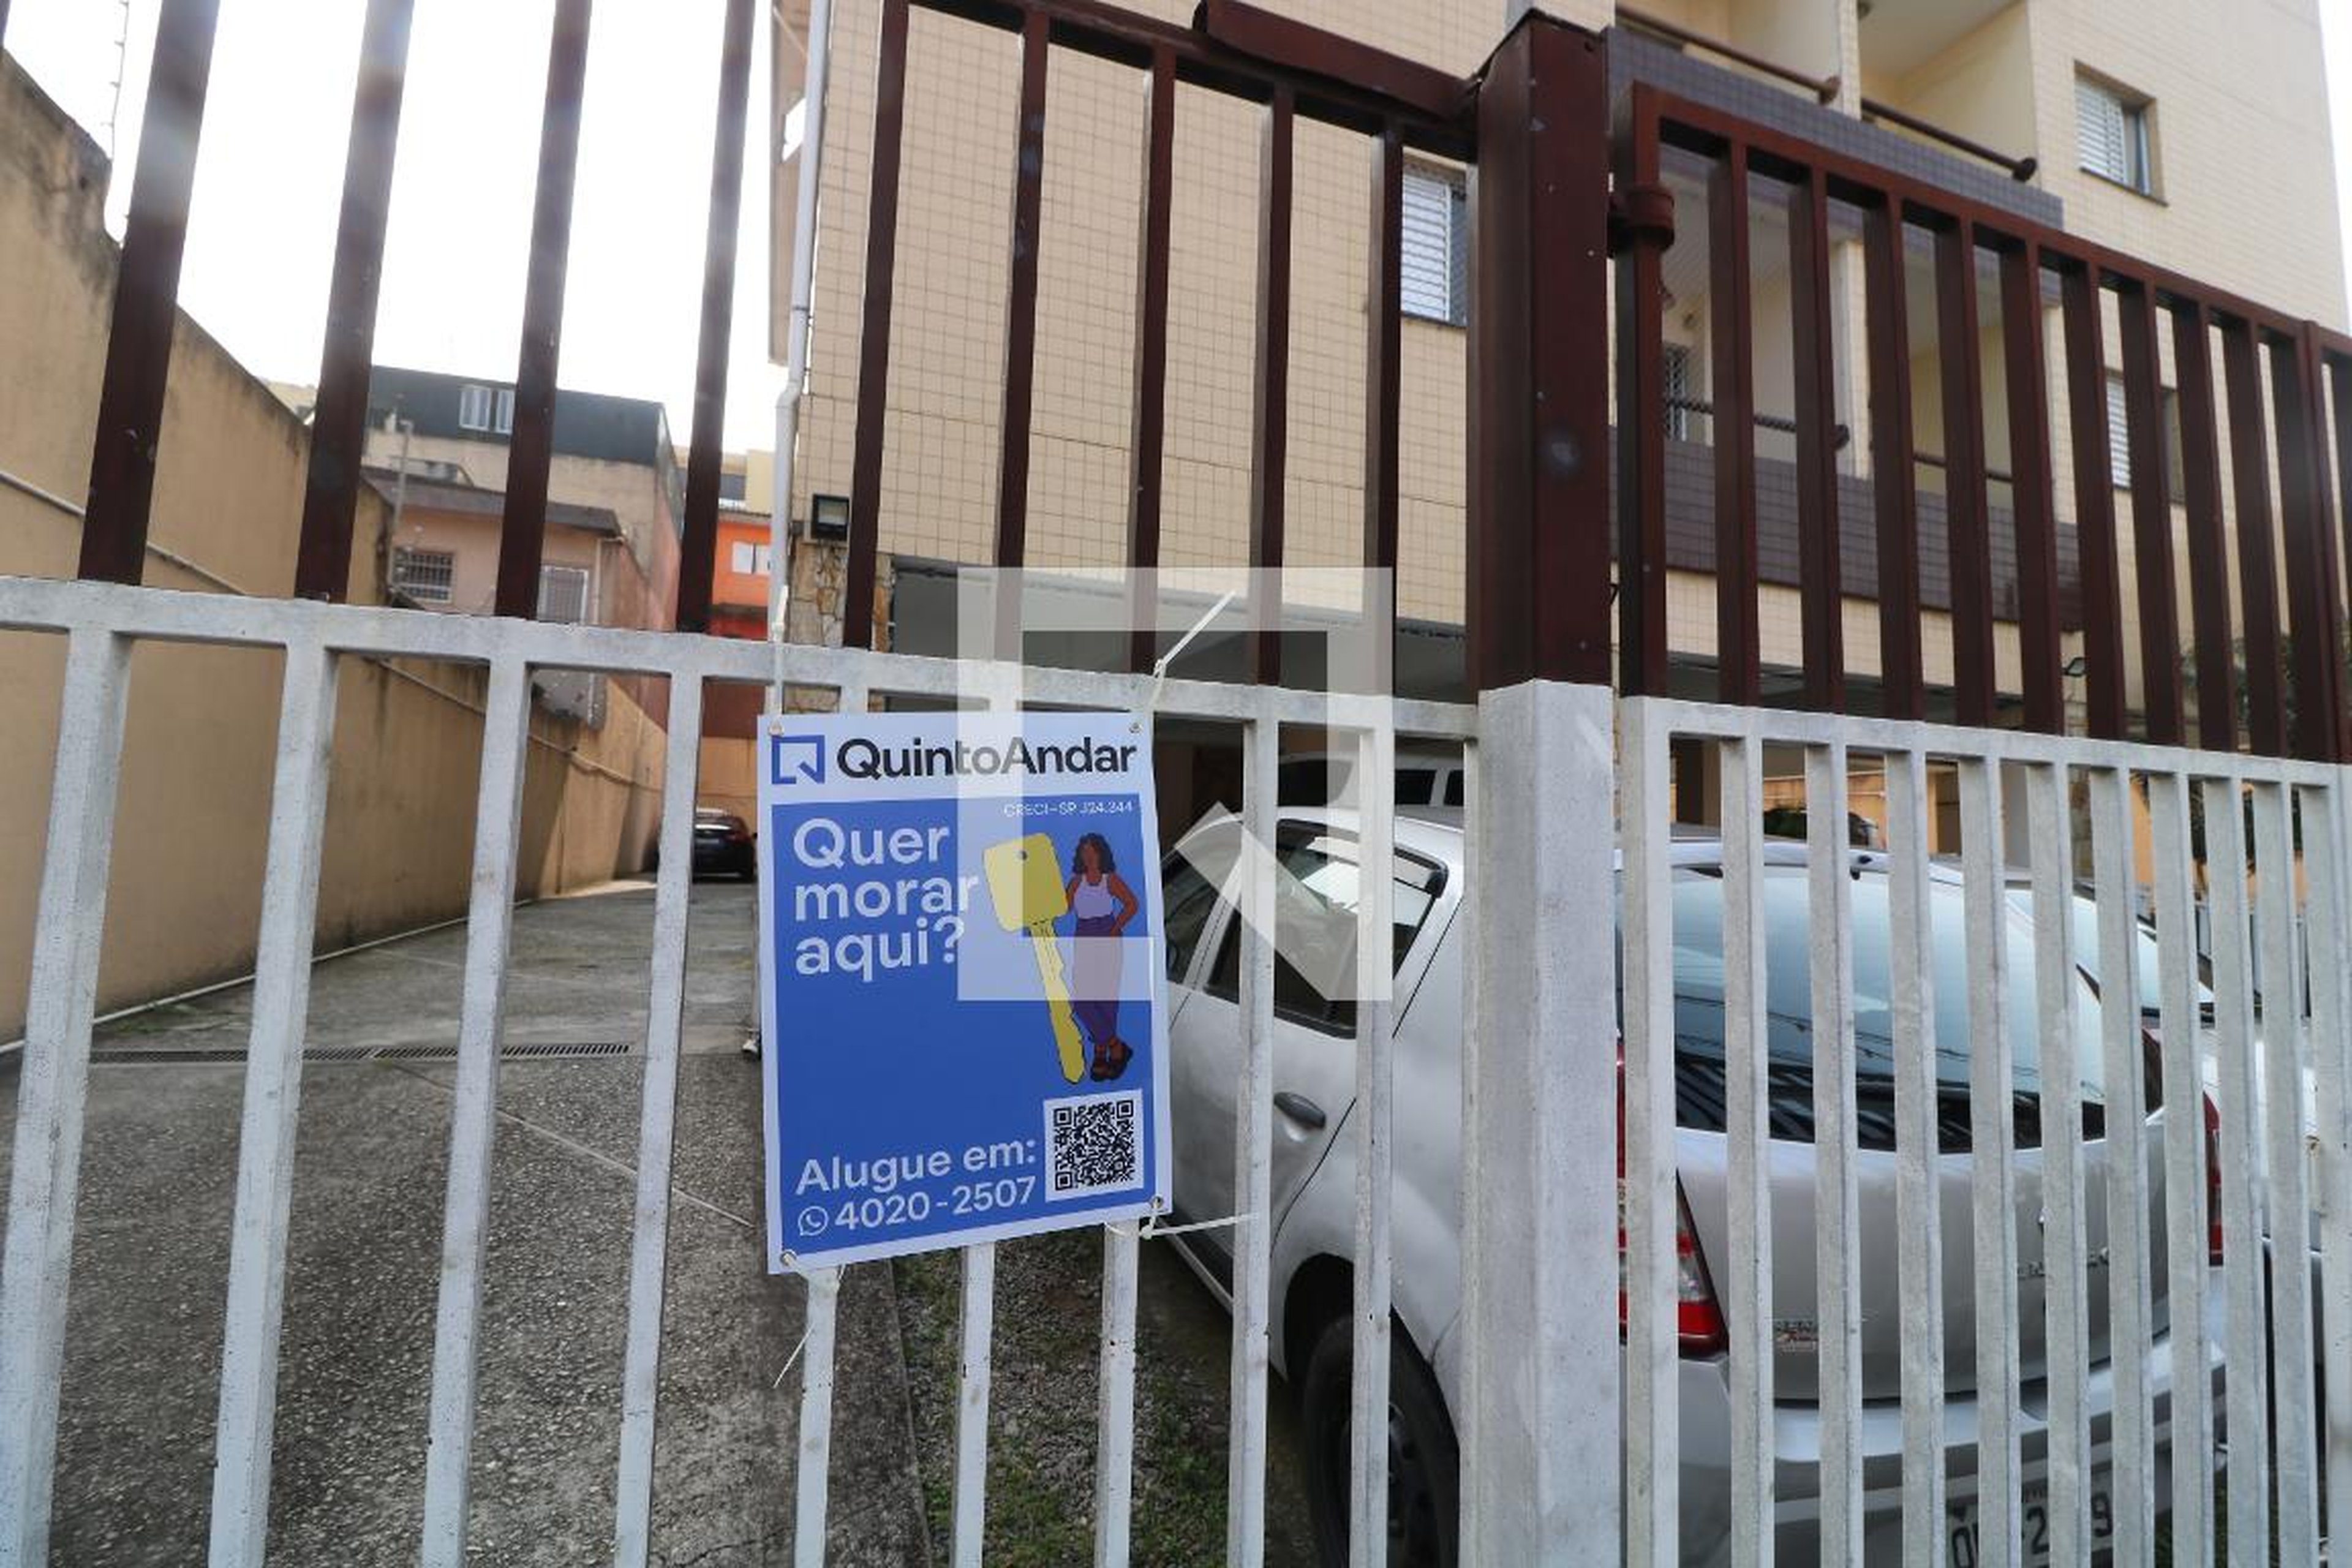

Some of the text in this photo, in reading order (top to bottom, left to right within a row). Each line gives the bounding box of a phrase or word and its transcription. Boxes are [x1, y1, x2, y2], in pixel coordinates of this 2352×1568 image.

[837, 736, 1137, 780] QuintoAndar
[793, 817, 951, 869] Quer
[796, 874, 980, 921] morar
[795, 915, 965, 982] aqui?
[796, 1138, 1038, 1195] Alugue em:
